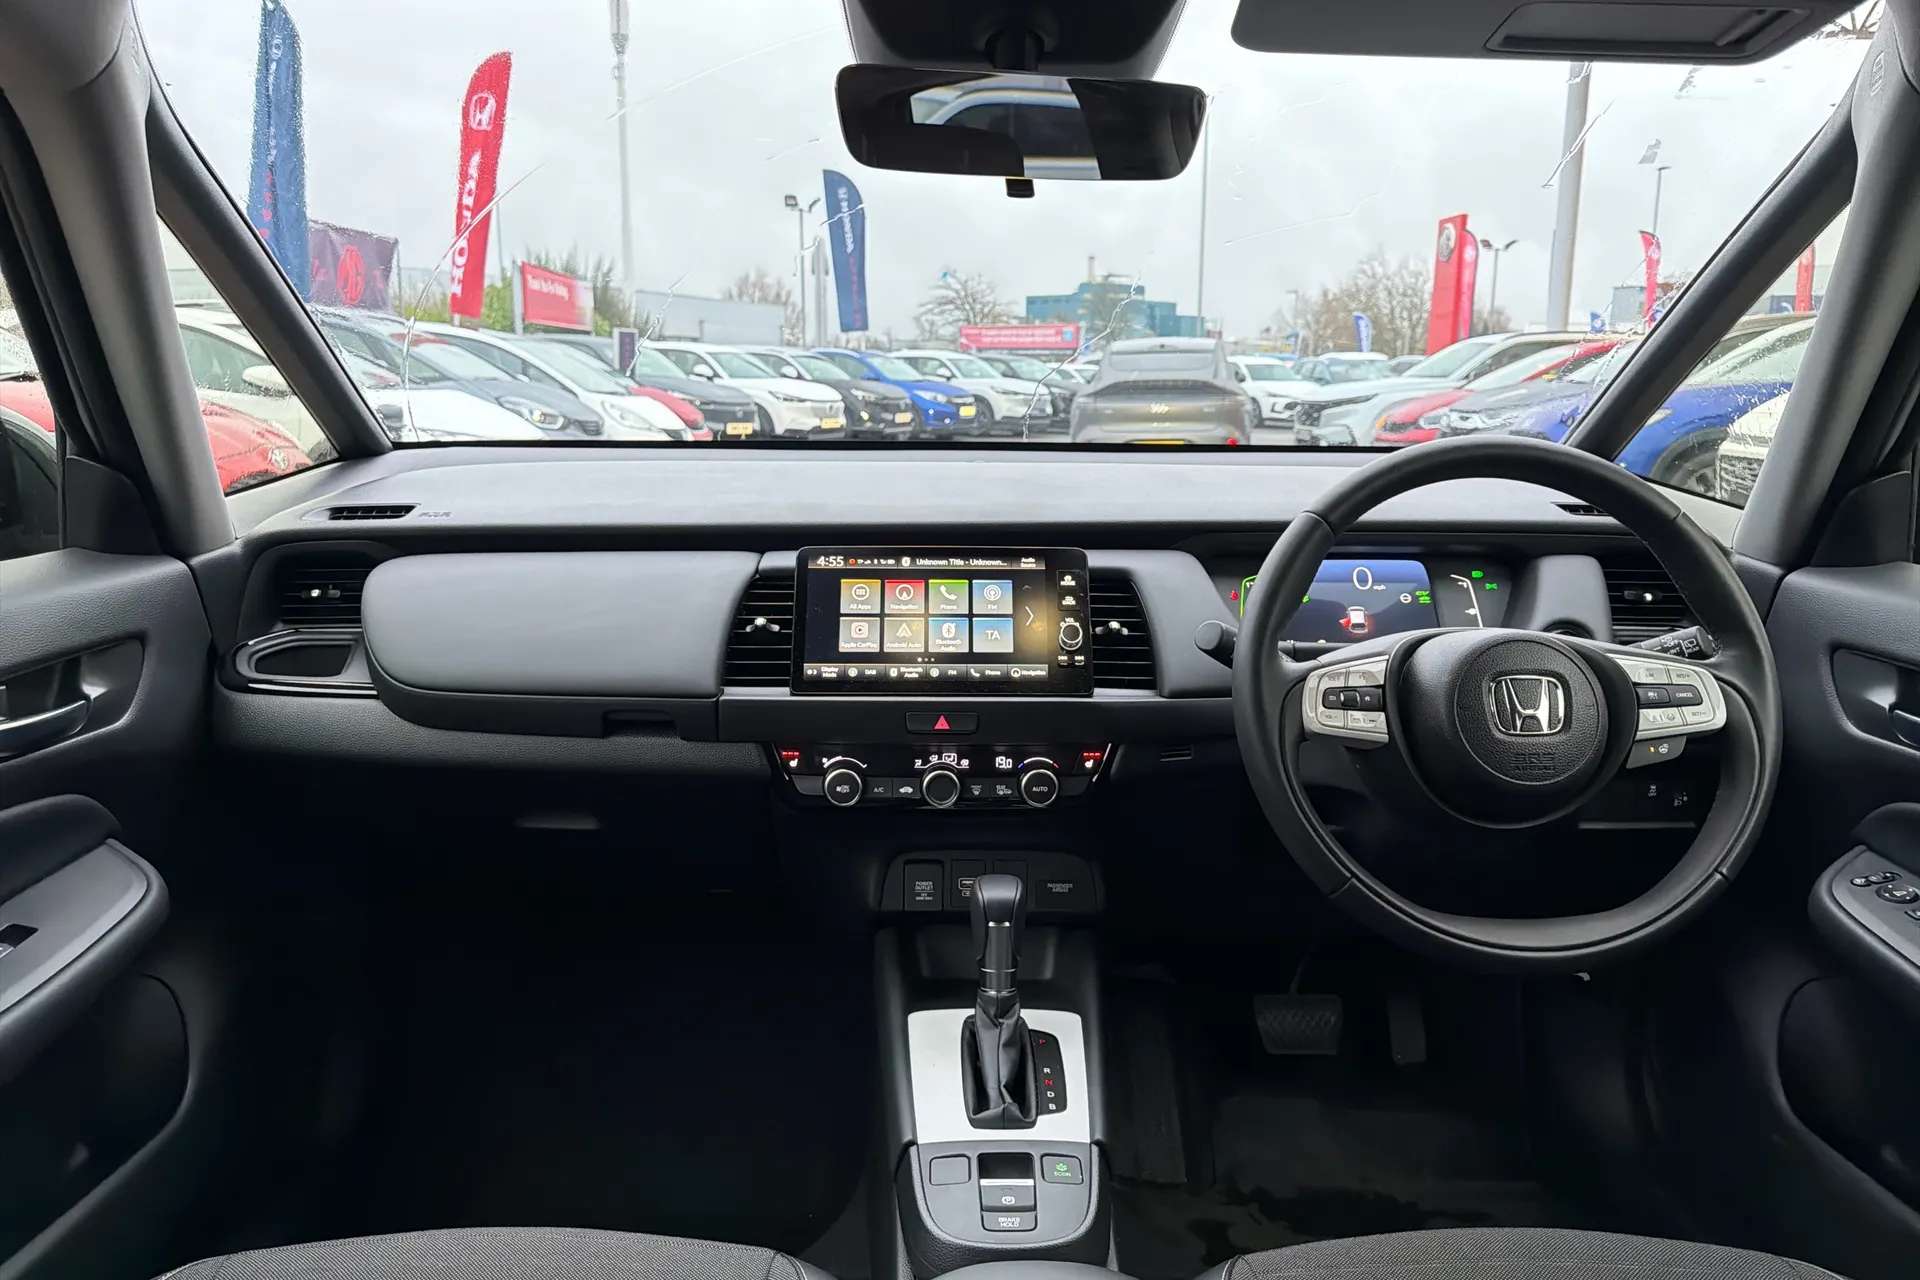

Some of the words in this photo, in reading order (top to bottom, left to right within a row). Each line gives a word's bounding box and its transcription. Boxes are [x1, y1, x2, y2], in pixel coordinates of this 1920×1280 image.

[817, 556, 844, 567] 4:55
[916, 558, 948, 566] Unknown
[949, 558, 964, 566] Title
[1353, 567, 1373, 590] 0
[985, 630, 1001, 640] TA
[820, 665, 839, 673] Display
[995, 755, 1013, 769] 19.0
[1043, 1067, 1051, 1075] R
